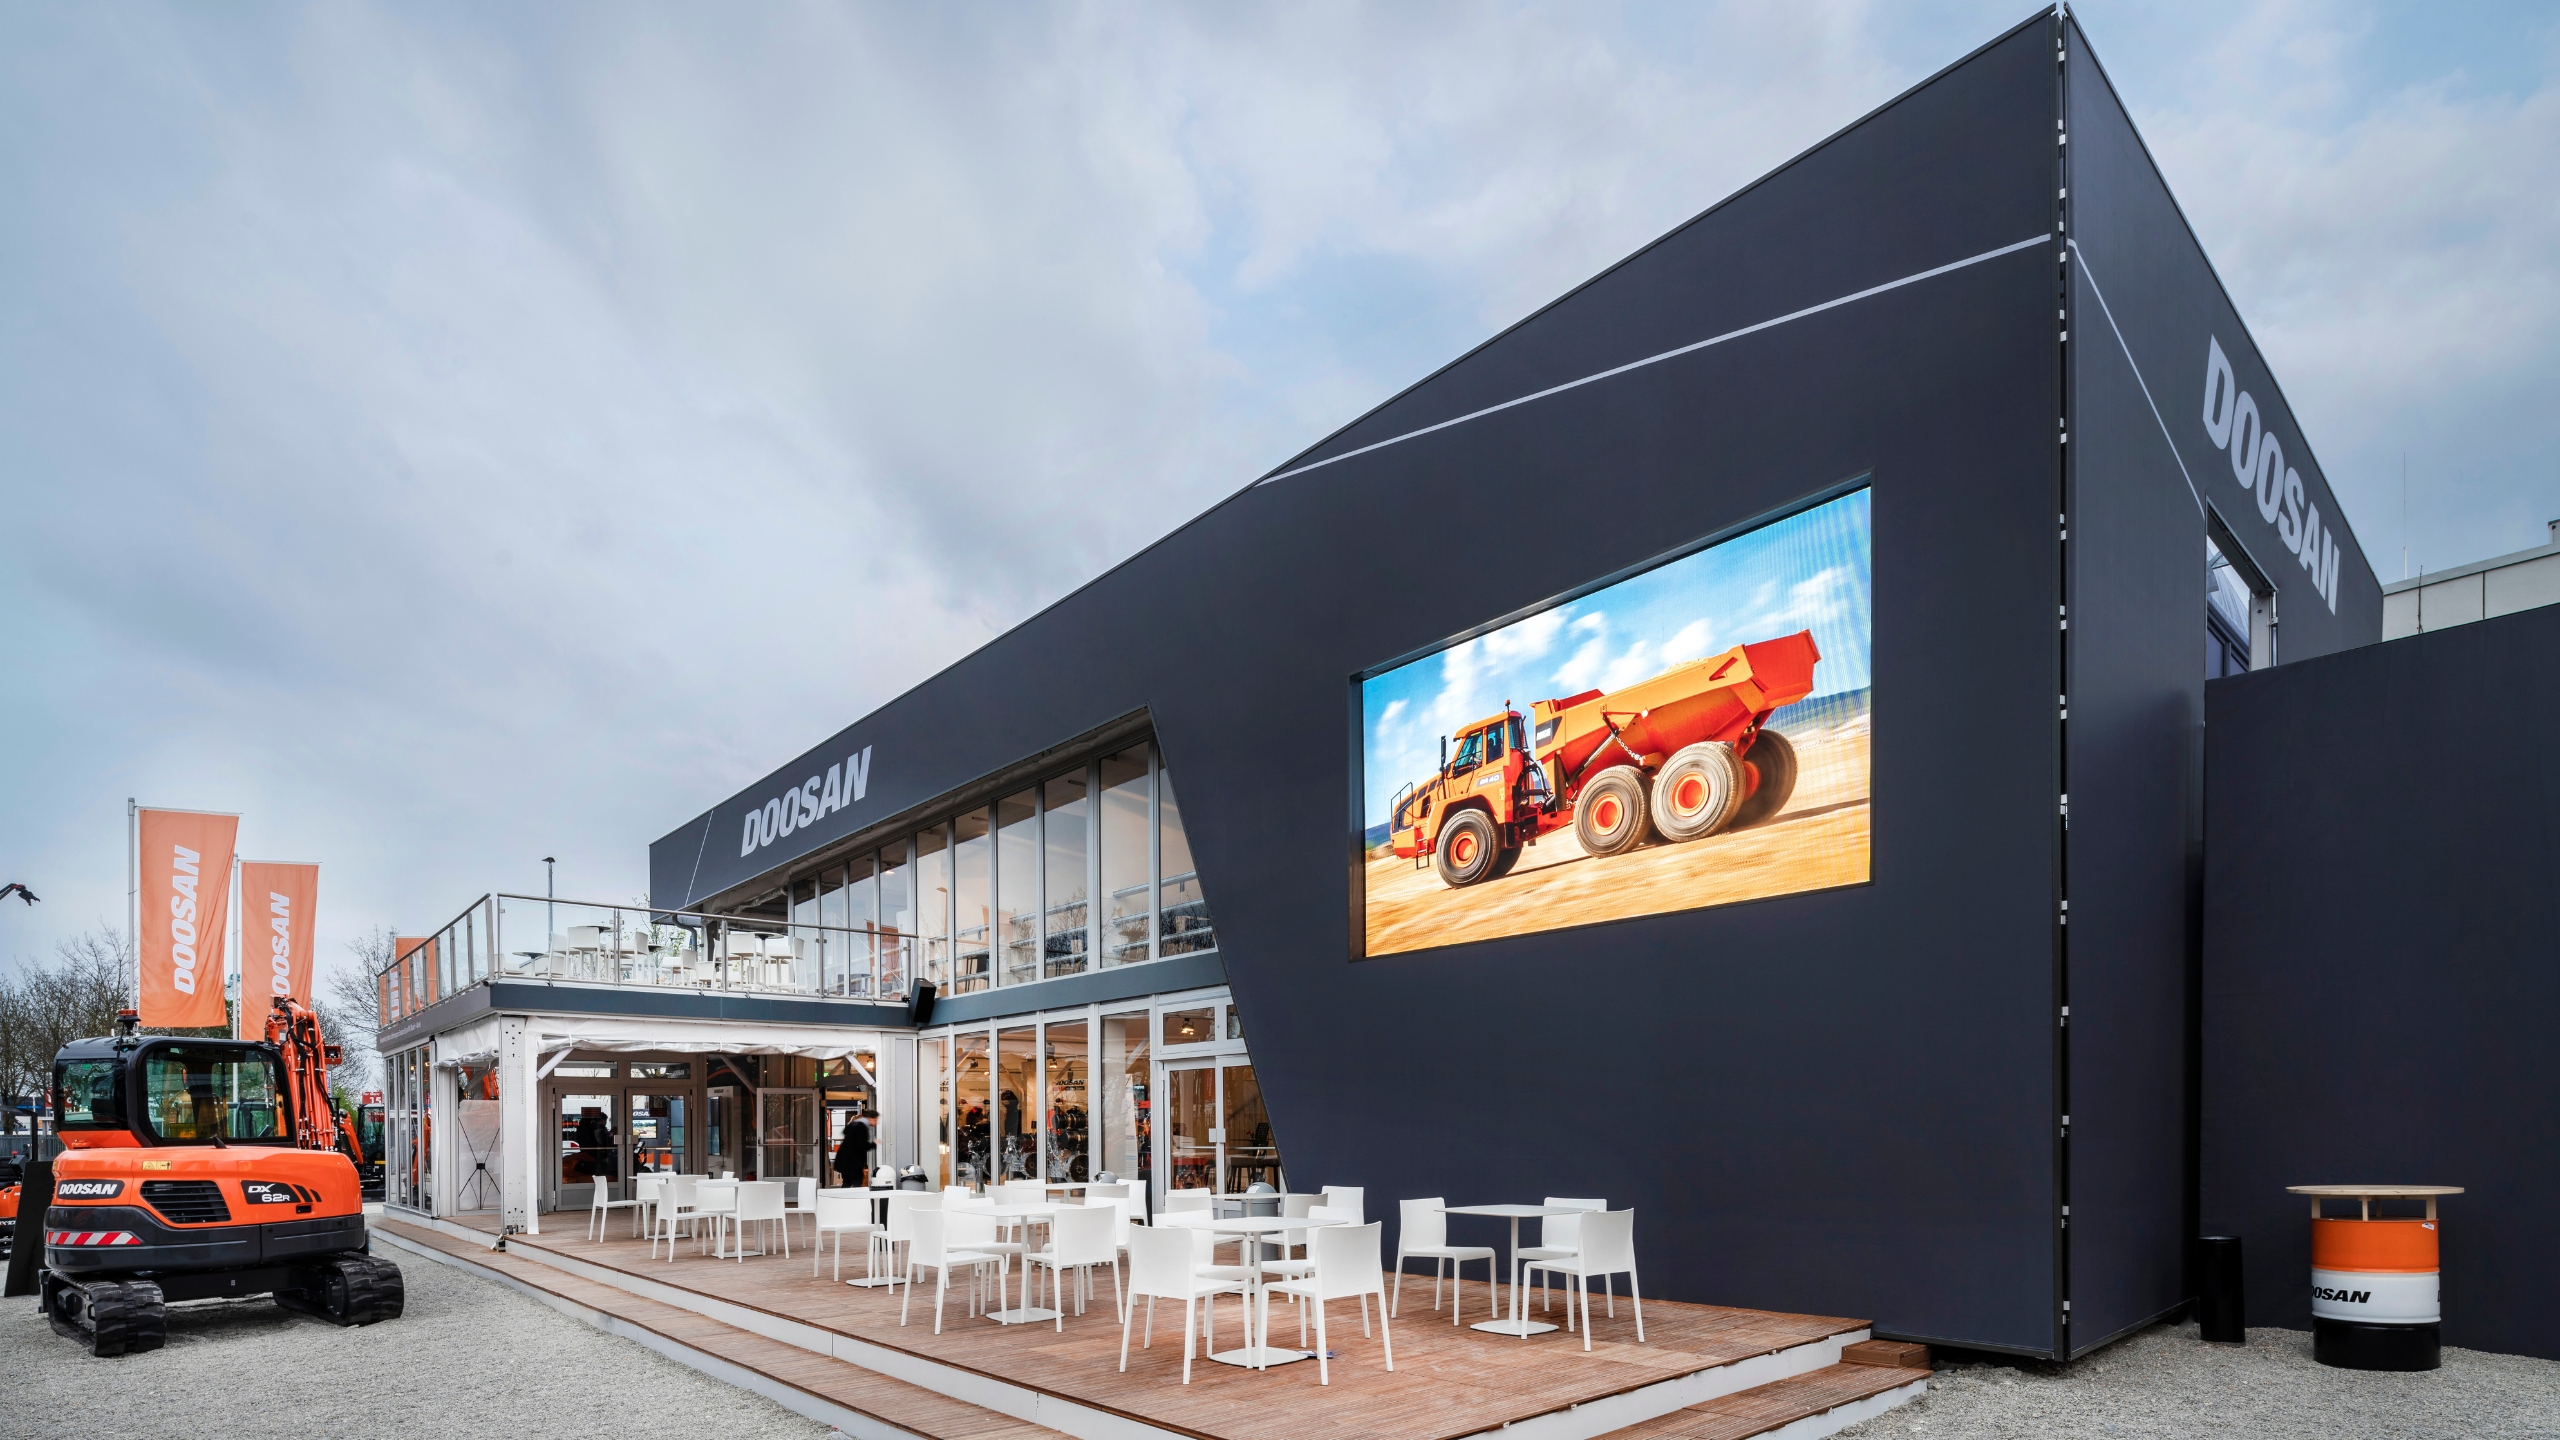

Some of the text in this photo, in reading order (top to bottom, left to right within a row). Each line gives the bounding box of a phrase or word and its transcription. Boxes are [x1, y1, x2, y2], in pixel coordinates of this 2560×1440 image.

[2203, 333, 2340, 616] DOOSAN
[740, 744, 872, 858] DOOSAN
[171, 844, 200, 995] DOOSAN
[270, 891, 291, 995] OOSAN
[58, 1183, 118, 1195] DOOSAN
[248, 1183, 276, 1194] DX
[261, 1193, 290, 1203] 62R
